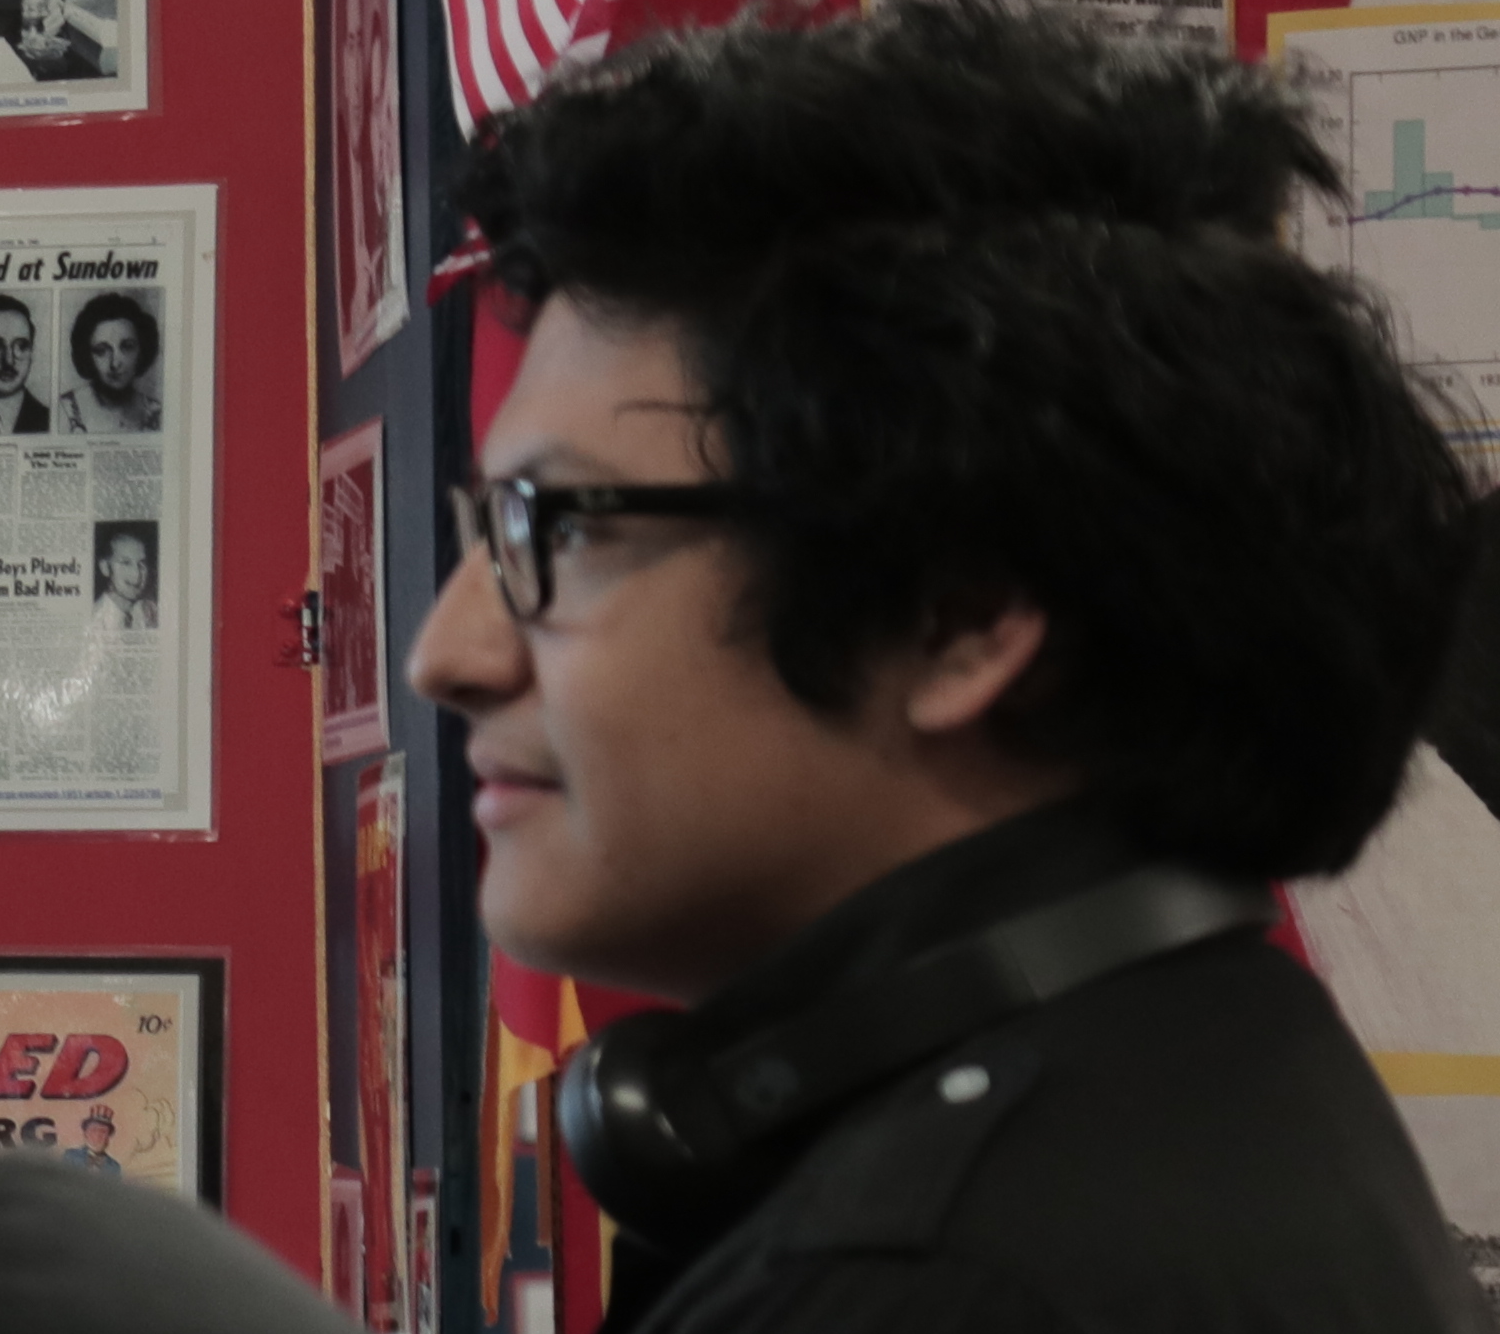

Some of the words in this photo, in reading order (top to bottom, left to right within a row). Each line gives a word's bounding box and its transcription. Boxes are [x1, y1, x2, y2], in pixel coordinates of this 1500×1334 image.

[1393, 28, 1428, 45] GNP
[1434, 31, 1446, 42] in
[1451, 28, 1474, 41] the
[18, 258, 44, 281] at
[52, 250, 158, 281] Sundown
[30, 557, 80, 576] Played;
[13, 577, 40, 596] Bad
[44, 580, 80, 595] News
